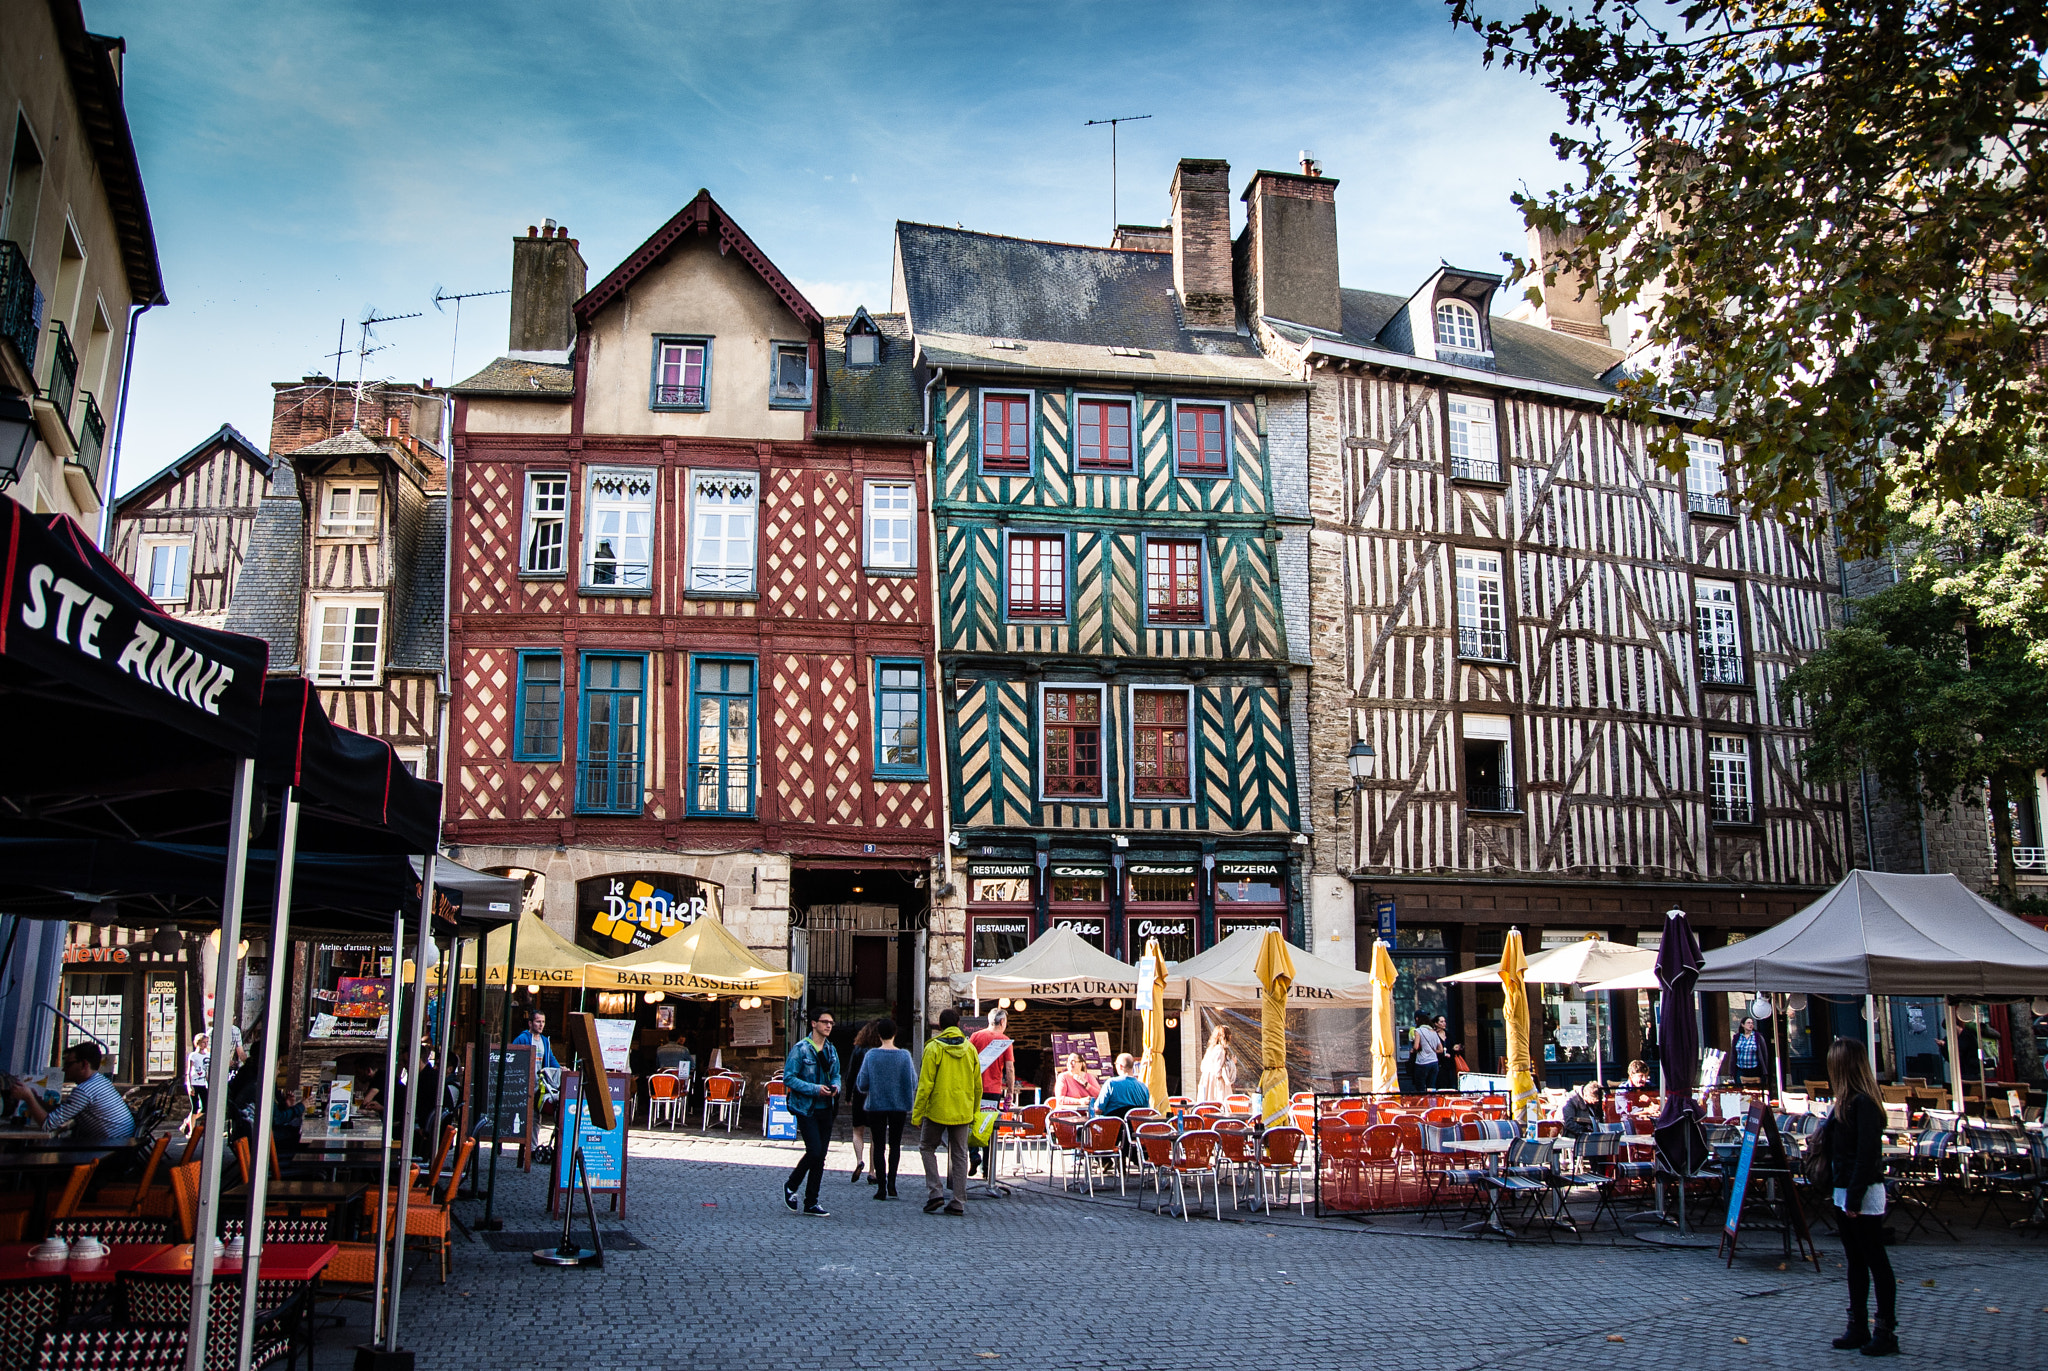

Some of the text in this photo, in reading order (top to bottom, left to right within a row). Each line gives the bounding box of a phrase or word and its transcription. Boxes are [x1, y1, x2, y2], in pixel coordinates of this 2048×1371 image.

[22, 563, 234, 716] STE ANNE
[972, 865, 1030, 875] RESTAURANT
[1054, 866, 1105, 876] Côte
[1129, 865, 1194, 874] Ouest
[1222, 865, 1278, 874] PIZZERIA
[609, 878, 625, 895] le
[975, 924, 1026, 933] RESTAURANT
[1137, 919, 1187, 938] Ouest
[635, 929, 652, 942] BAR
[319, 943, 342, 951] Atelier
[343, 943, 371, 951] d'artiste
[617, 971, 759, 991] BAR BRASSERIE
[1030, 981, 1138, 995] RESTAURANT
